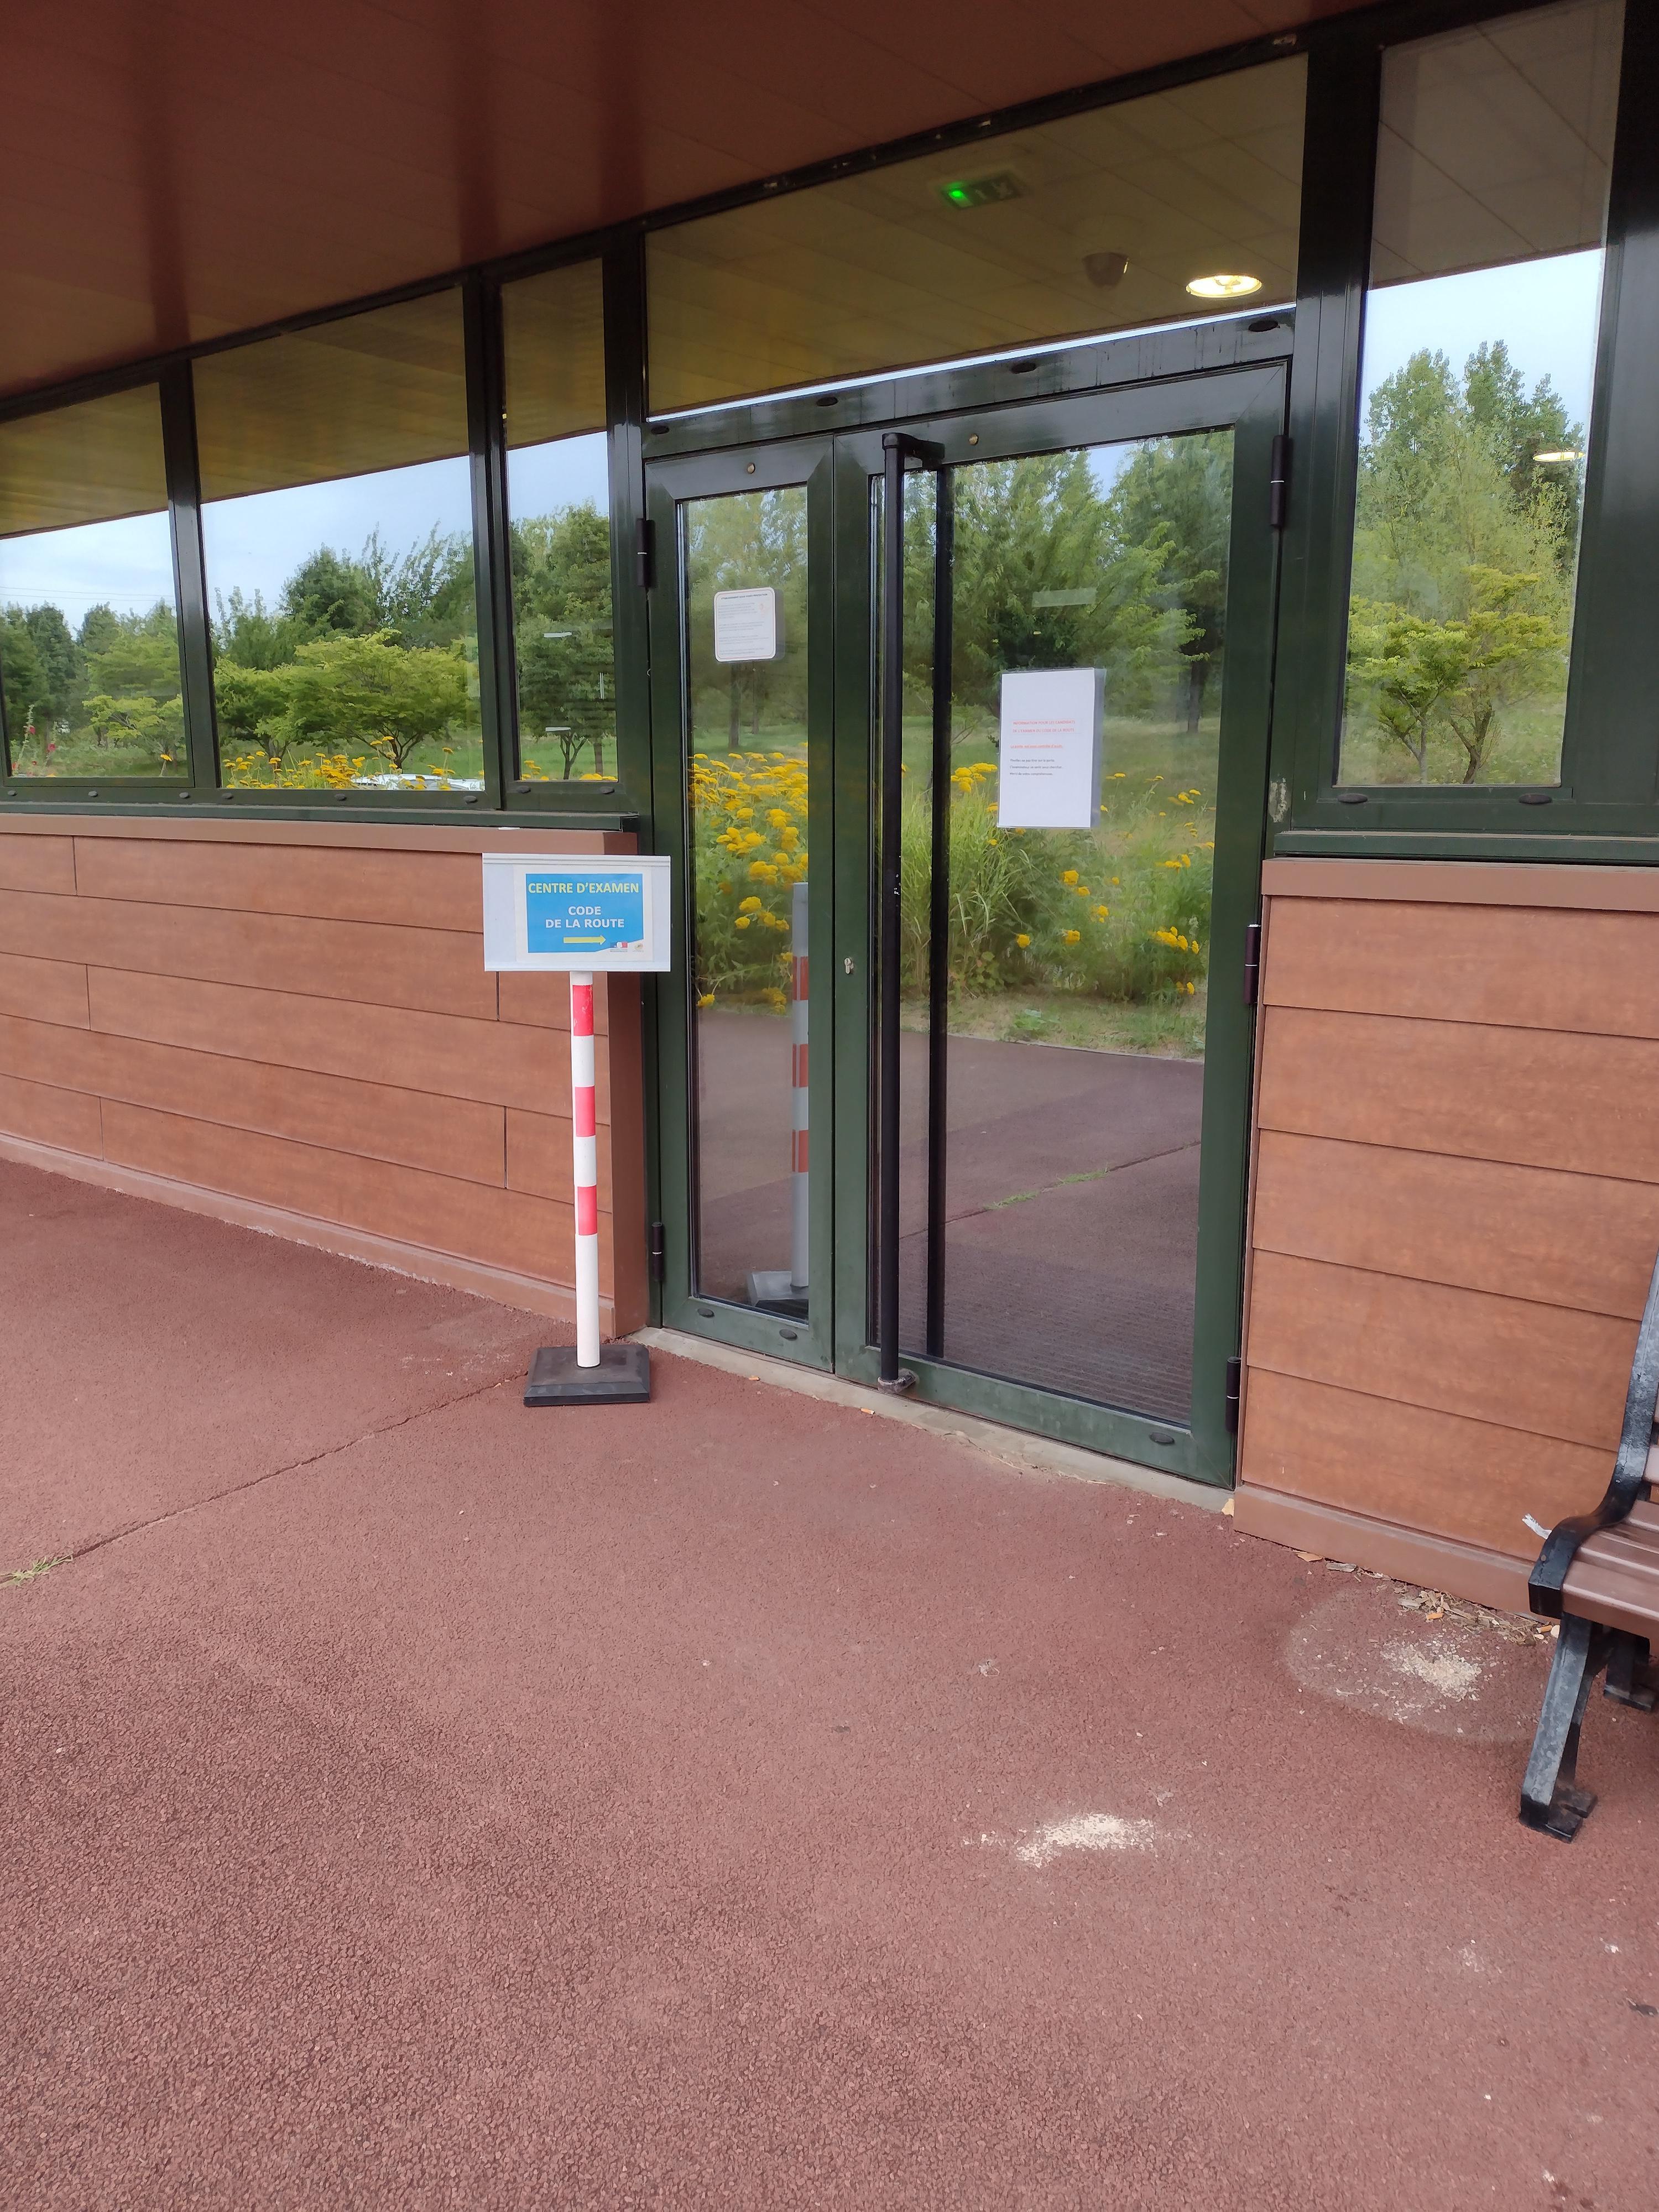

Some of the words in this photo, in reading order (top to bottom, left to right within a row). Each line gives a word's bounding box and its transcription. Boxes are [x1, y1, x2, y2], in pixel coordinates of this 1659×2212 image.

[528, 883, 573, 893] CENTRE
[577, 882, 639, 893] D'EXAMEN
[568, 906, 601, 916] CODE
[545, 919, 561, 928] DE
[565, 919, 580, 928] LA
[585, 919, 624, 928] ROUTE
